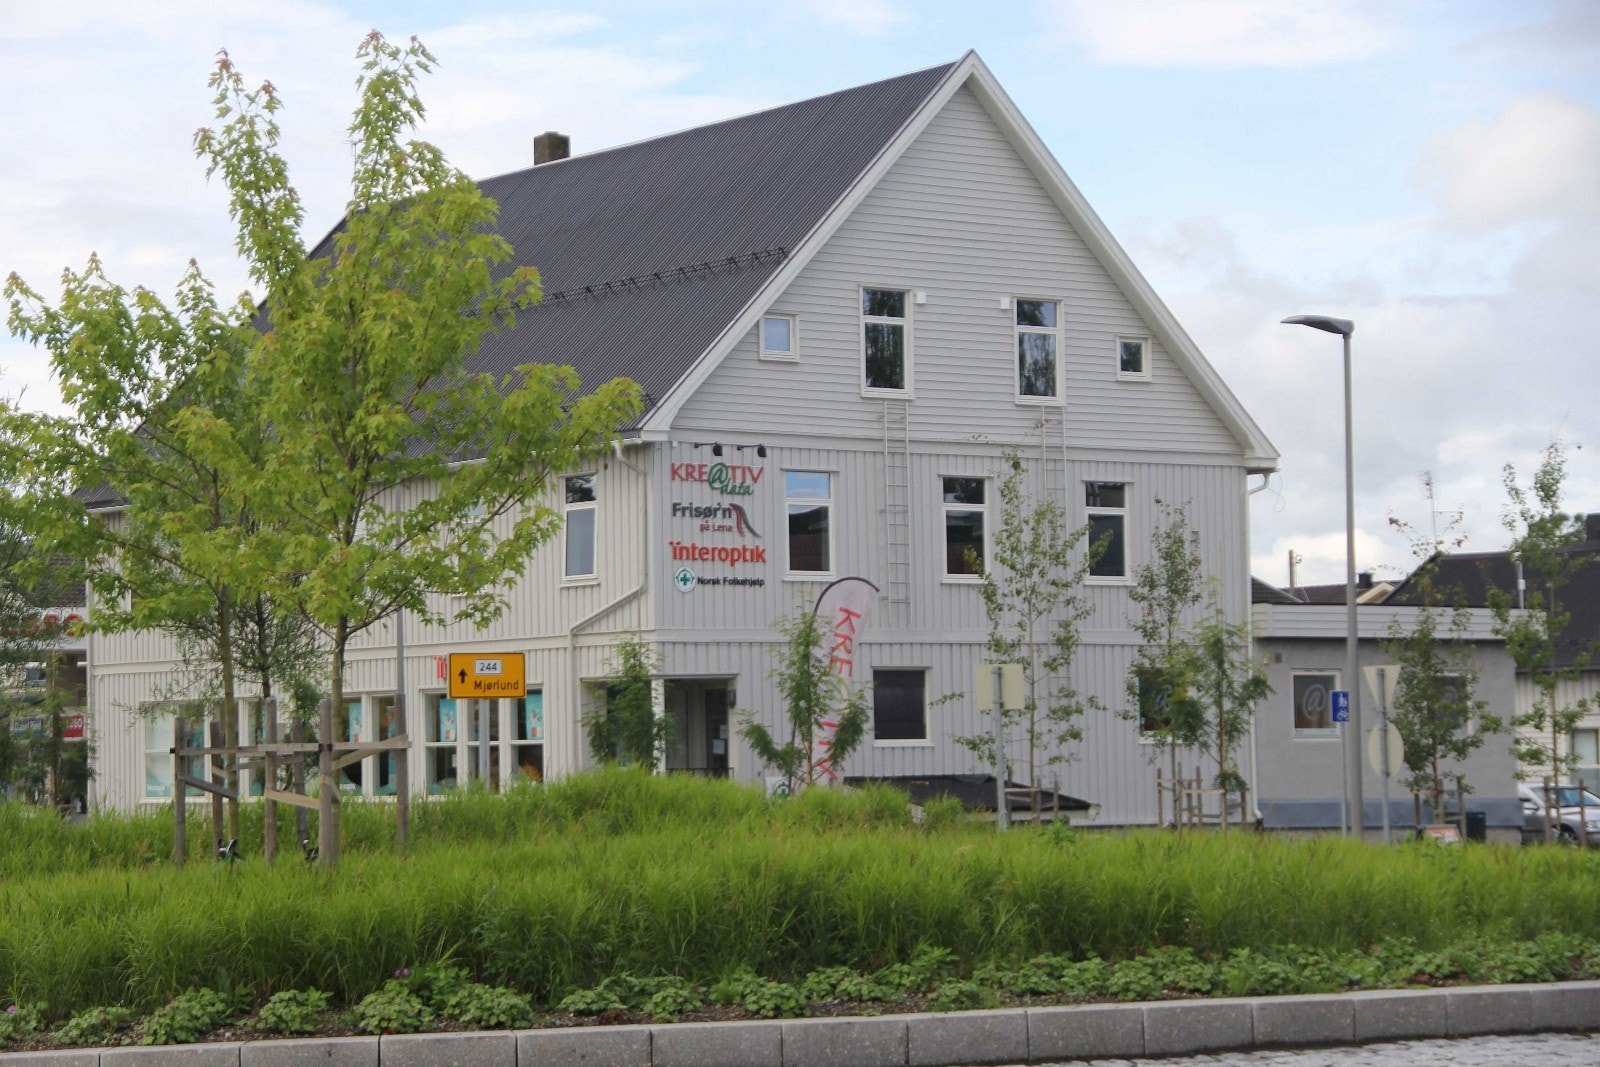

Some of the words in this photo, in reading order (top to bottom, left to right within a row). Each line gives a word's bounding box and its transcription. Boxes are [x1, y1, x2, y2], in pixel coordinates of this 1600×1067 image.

[671, 462, 764, 490] KRE@TIV
[719, 477, 755, 495] data
[700, 520, 710, 533] på
[713, 523, 733, 532] Lena
[697, 576, 721, 585] Norsk
[723, 577, 765, 587] Folkehjelp
[480, 662, 497, 671] 244
[474, 680, 519, 692] Mjørlund
